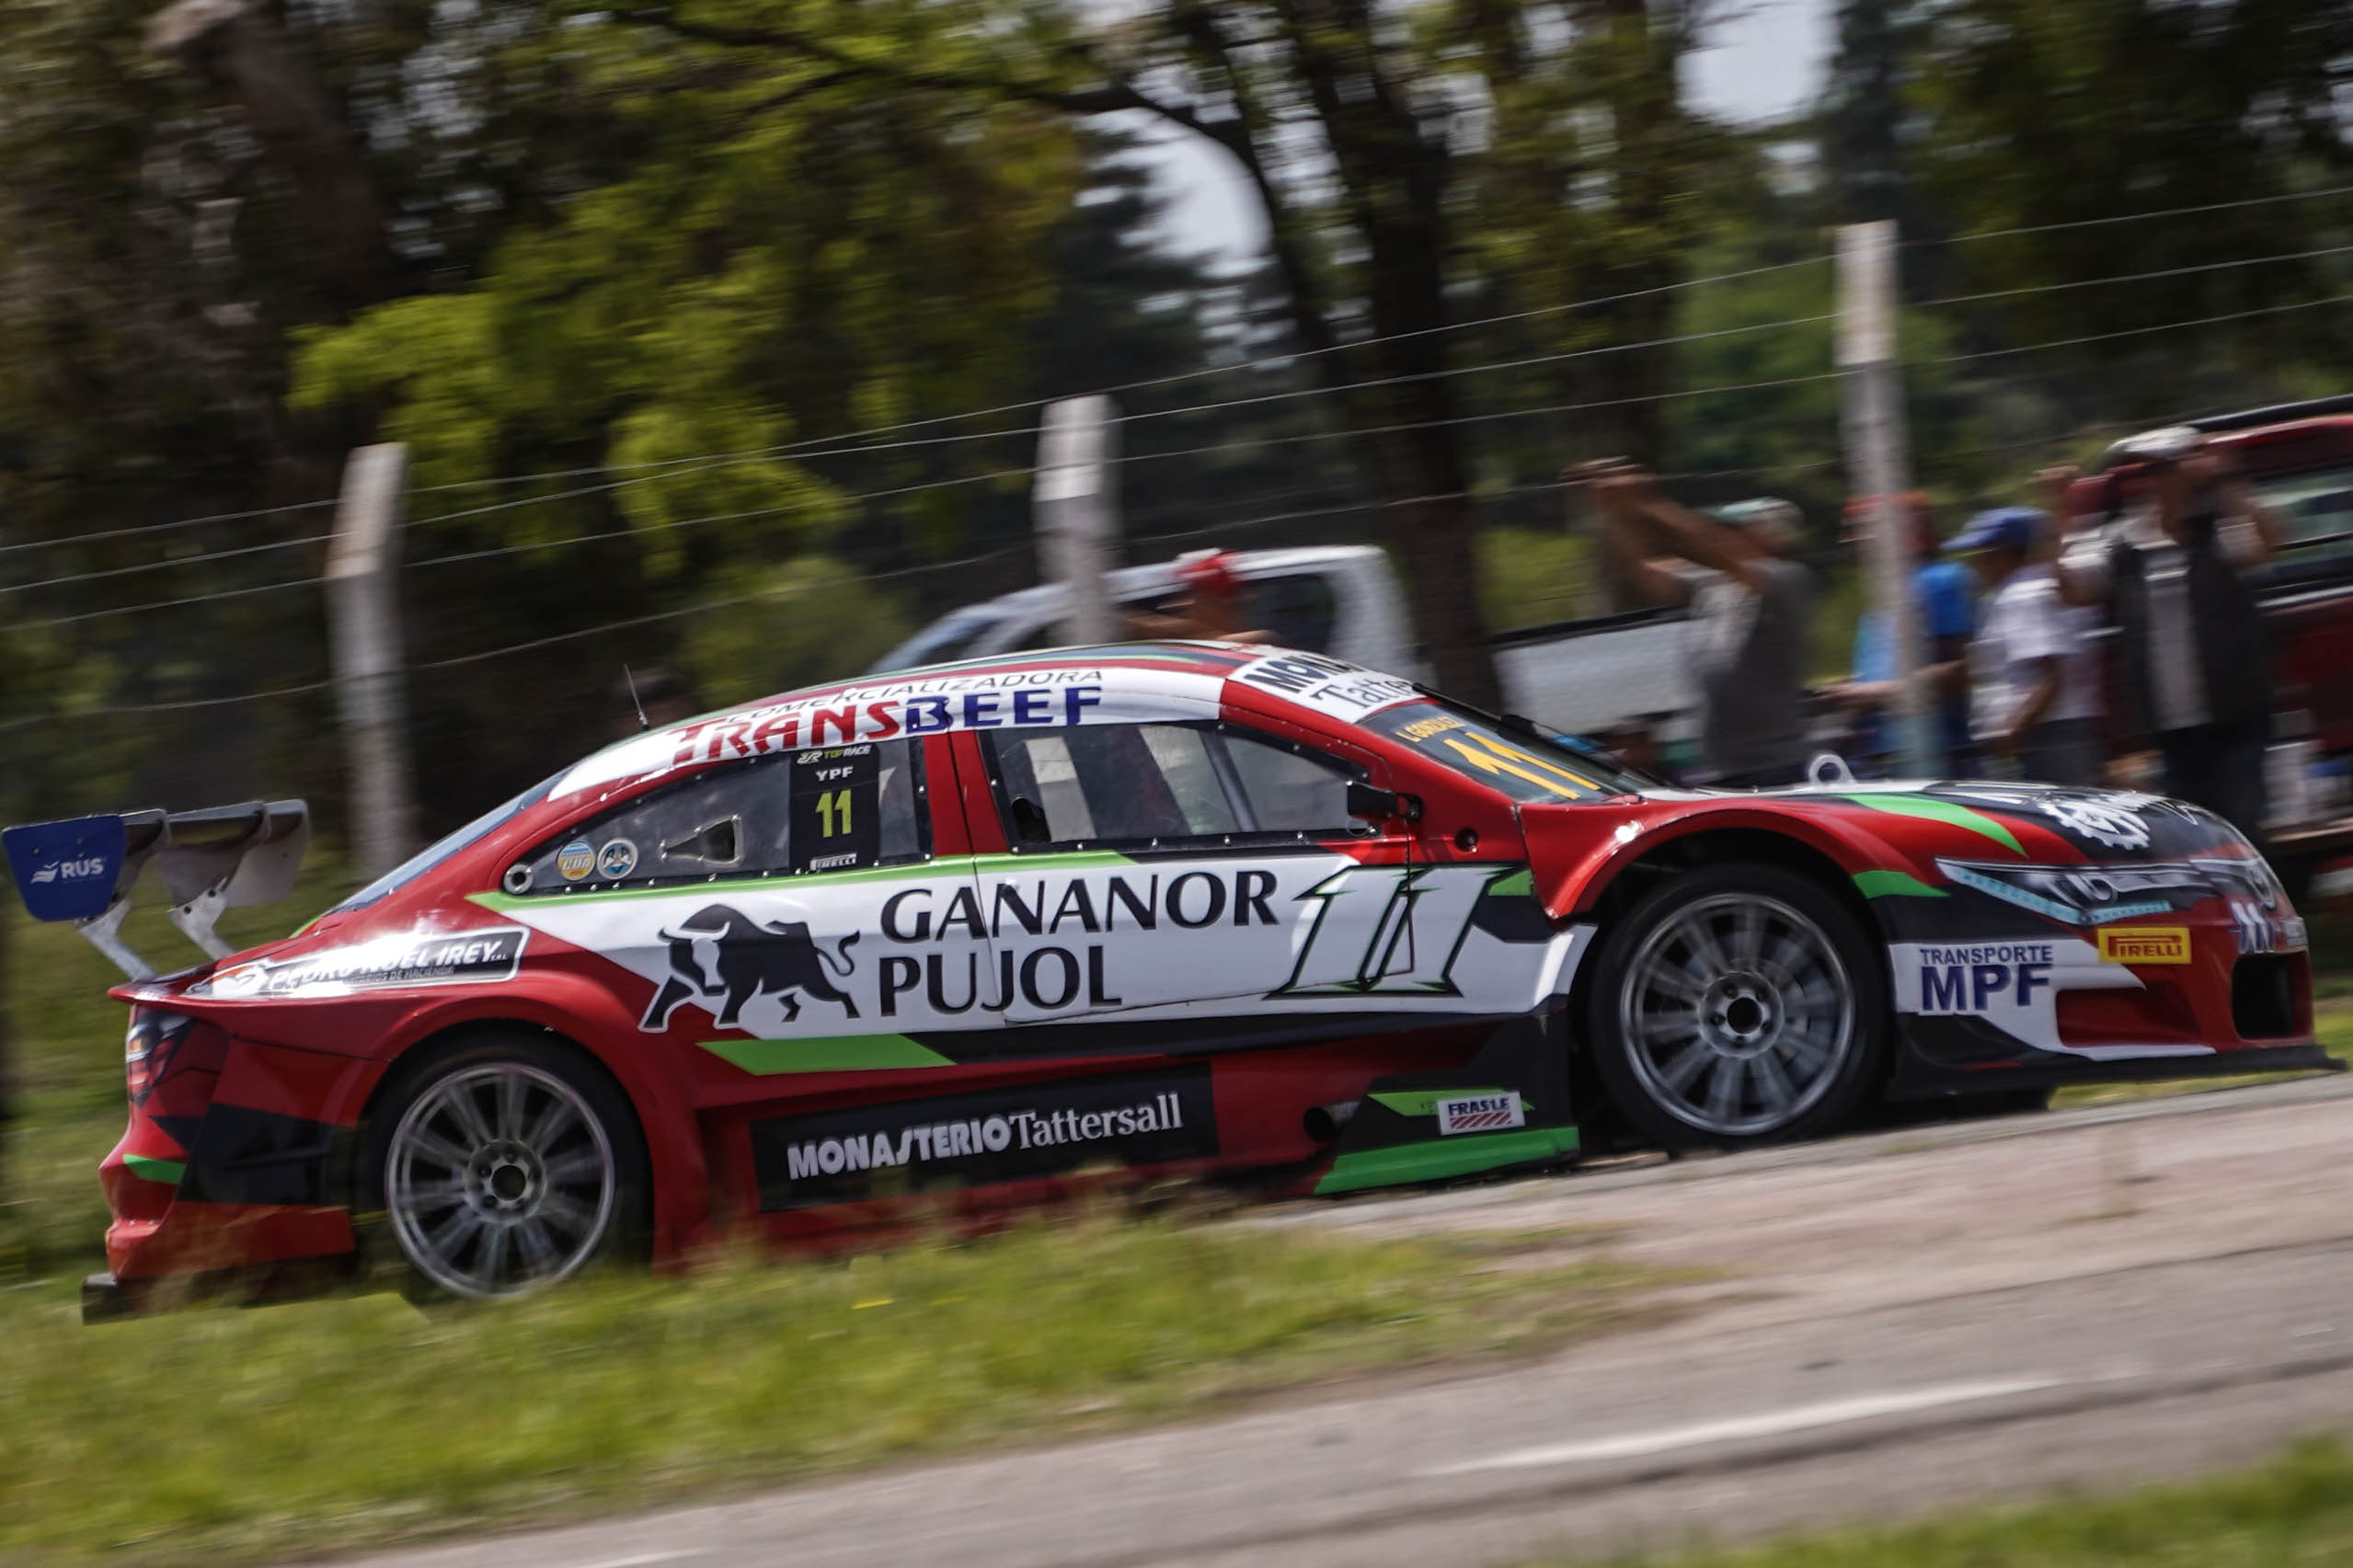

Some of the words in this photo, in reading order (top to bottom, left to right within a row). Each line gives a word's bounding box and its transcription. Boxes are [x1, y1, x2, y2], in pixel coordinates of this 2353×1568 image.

[728, 670, 1102, 723] COMERCIALIZADORA
[671, 686, 1102, 765] TRANSBEEF
[815, 766, 854, 782] YPF
[815, 788, 852, 838] 11
[60, 857, 104, 879] RUS
[809, 853, 856, 871] PIRELLI
[880, 870, 1279, 944] GANANOR
[1262, 861, 1527, 1001] 11
[1920, 944, 2053, 966] TRANSPORTE
[2107, 934, 2182, 957] PIRELLI
[879, 945, 1122, 1016] PUJOL
[1922, 963, 2053, 1012] MPF
[1008, 1091, 1183, 1150] Tattersall
